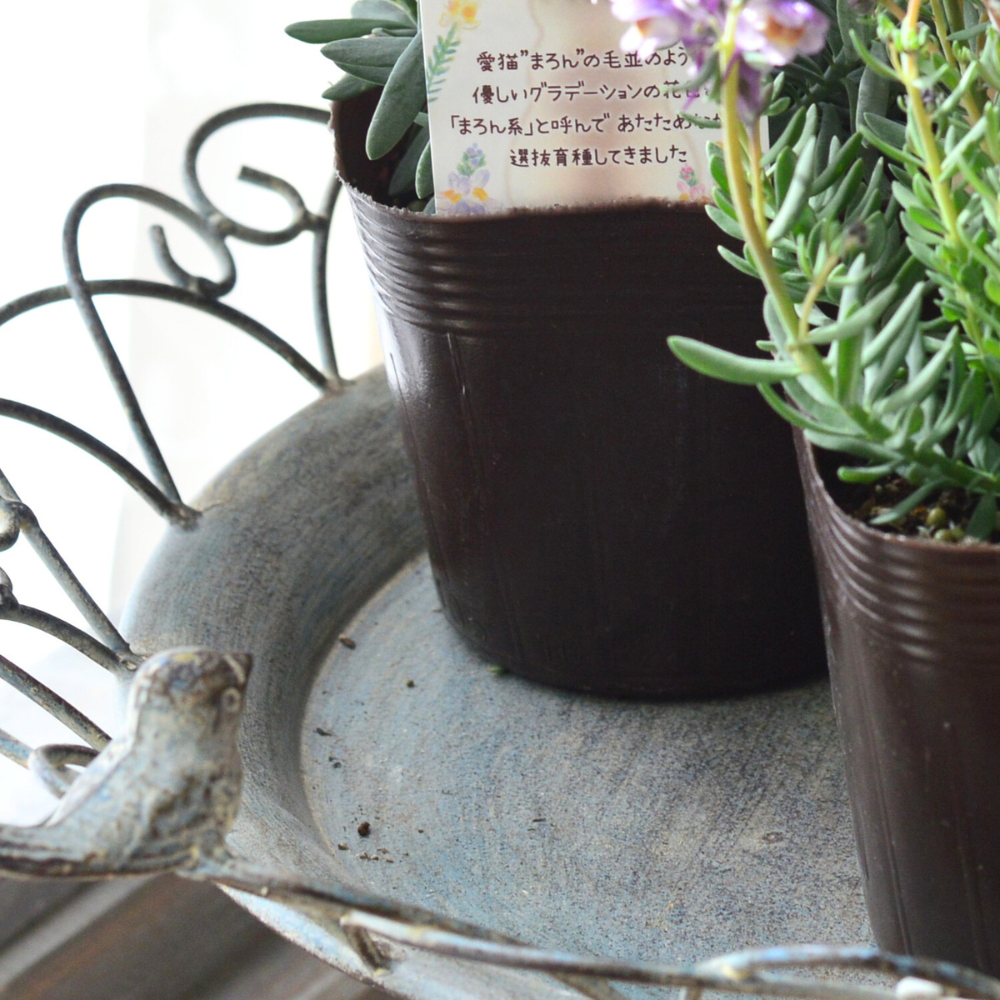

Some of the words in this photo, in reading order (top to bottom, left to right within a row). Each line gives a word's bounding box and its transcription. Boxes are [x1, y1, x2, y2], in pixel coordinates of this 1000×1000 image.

[509, 144, 688, 167] 選抜育種してきました
